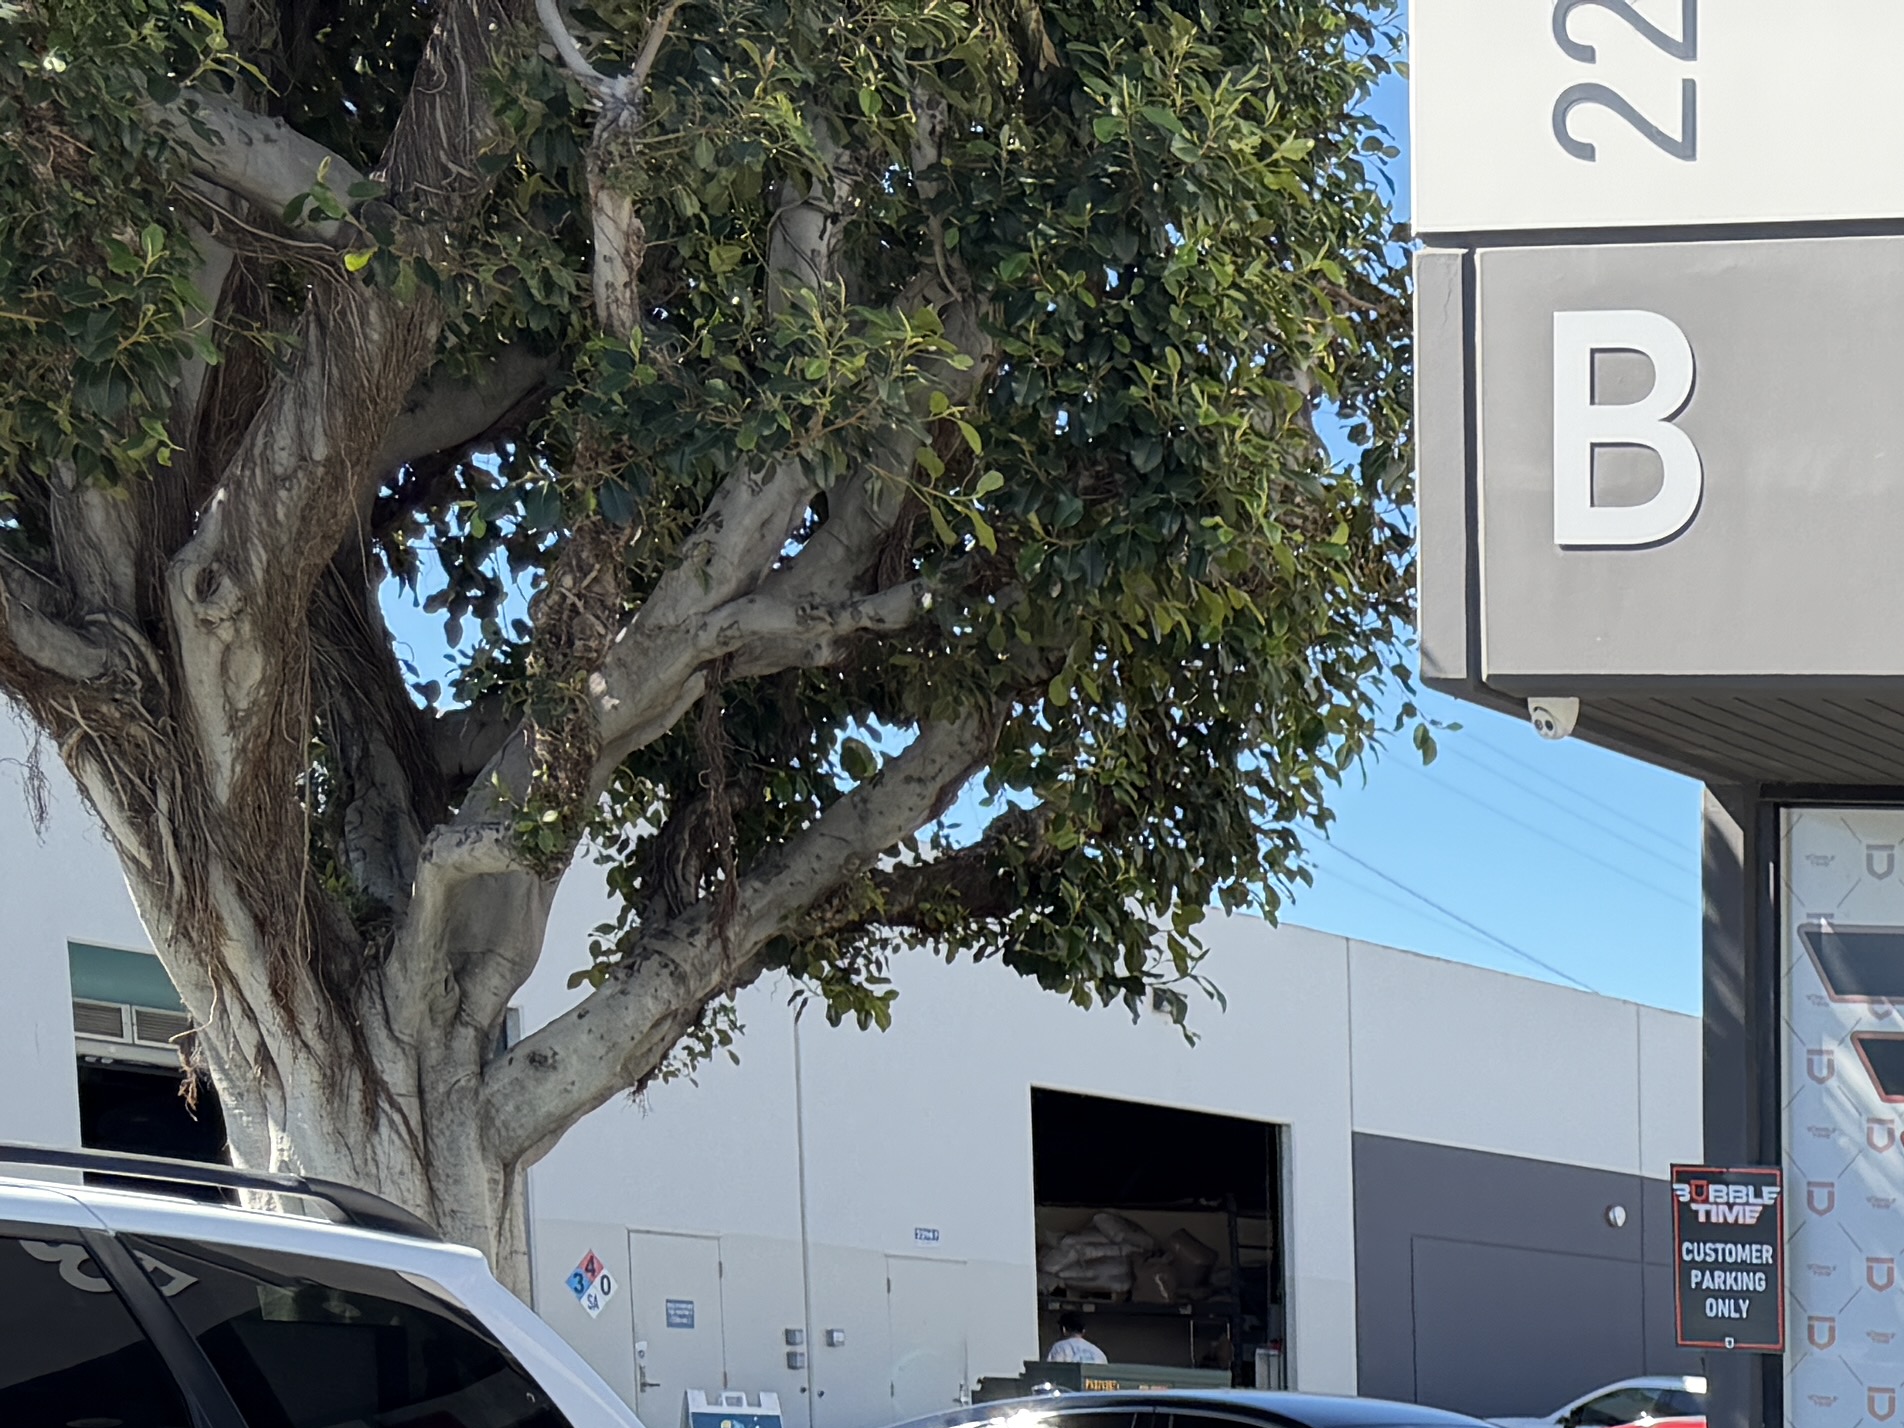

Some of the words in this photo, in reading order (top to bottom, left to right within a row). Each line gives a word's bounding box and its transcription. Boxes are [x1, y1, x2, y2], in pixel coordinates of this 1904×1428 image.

[1553, 309, 1704, 552] B
[1672, 1179, 1781, 1206] BUBBLE
[1690, 1203, 1763, 1225] TIME
[1681, 1241, 1773, 1265] CUSTOMER
[584, 1254, 596, 1277] 4
[572, 1271, 585, 1294] 3
[600, 1273, 612, 1296] 0
[1690, 1269, 1766, 1292] PARKING
[1705, 1297, 1750, 1319] ONLY
